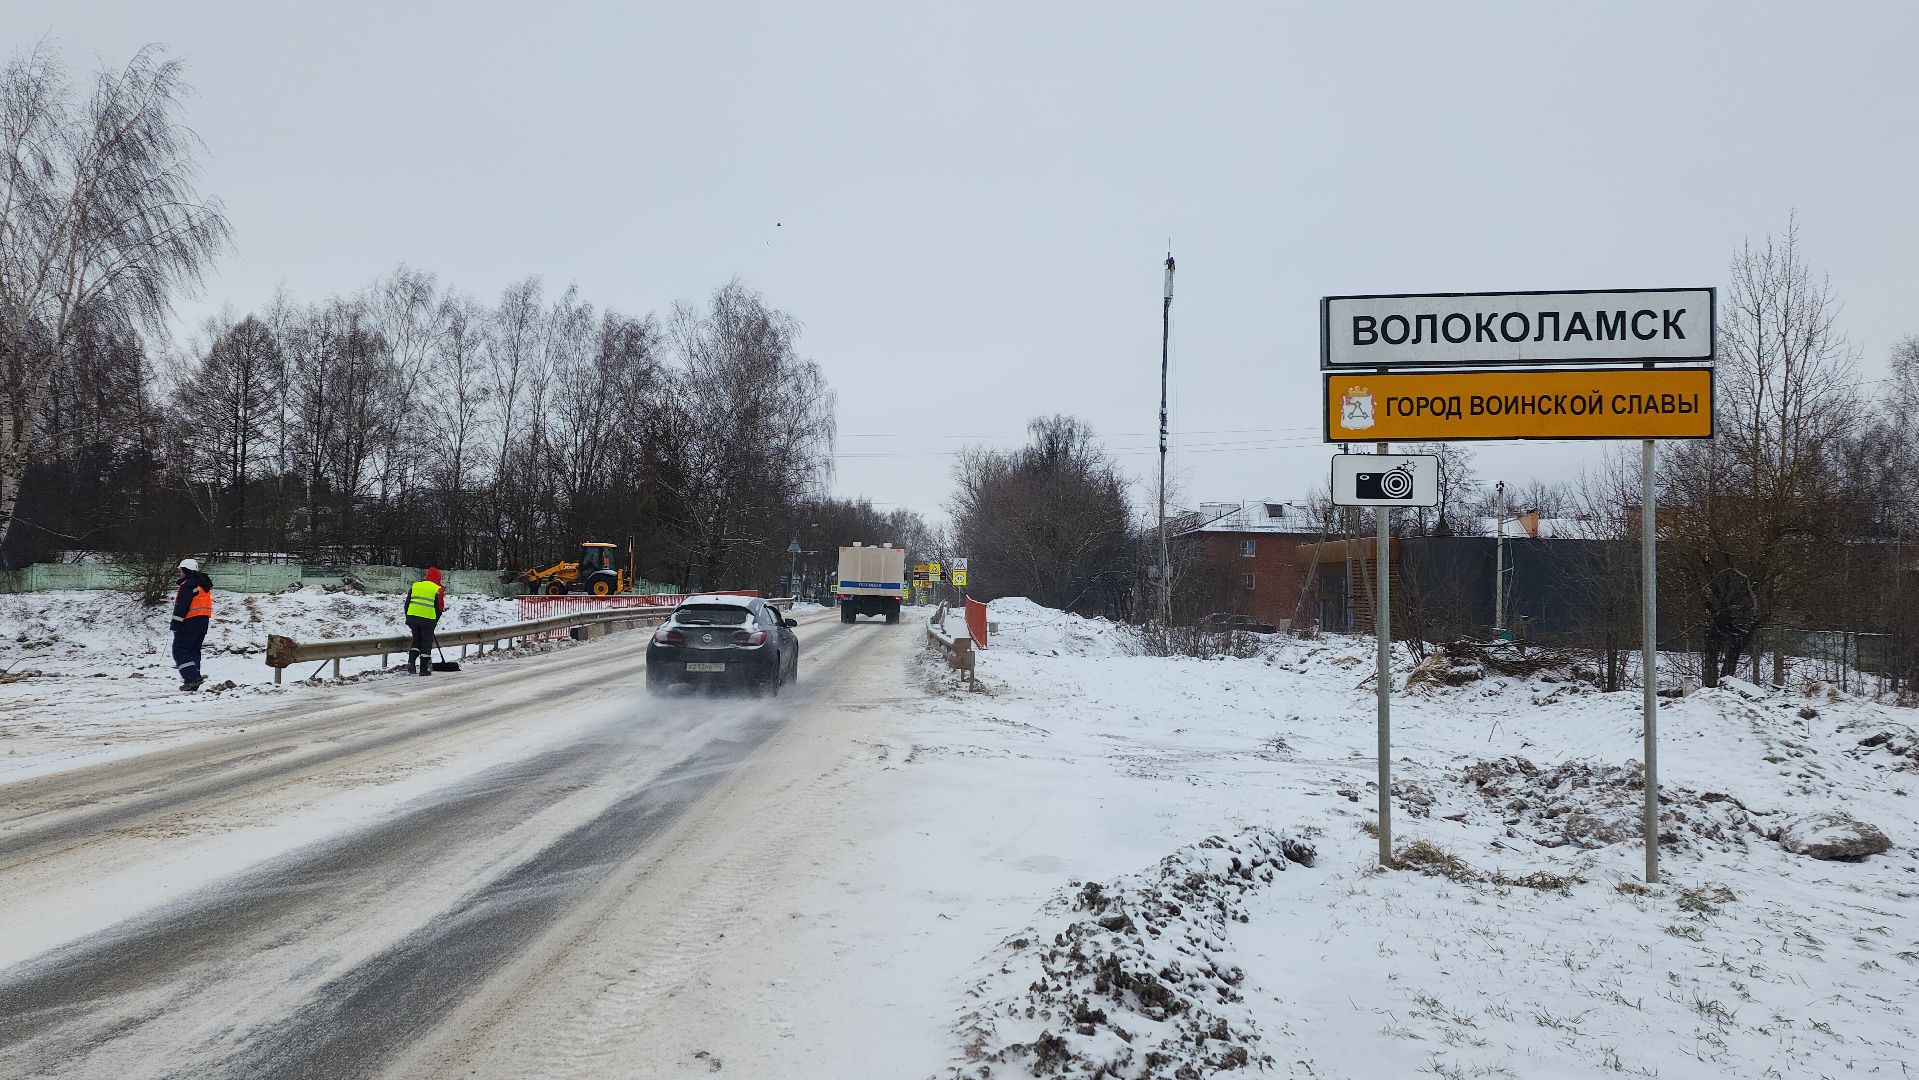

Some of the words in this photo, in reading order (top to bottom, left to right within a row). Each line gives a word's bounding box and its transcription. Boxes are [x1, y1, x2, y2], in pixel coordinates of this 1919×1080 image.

[1352, 308, 1687, 346] ВОЛОКОЛАМСК
[1386, 395, 1463, 421] ГОРОД
[1469, 389, 1603, 416] ВОИНСКОЙ
[1611, 393, 1699, 415] СЛАВЫ
